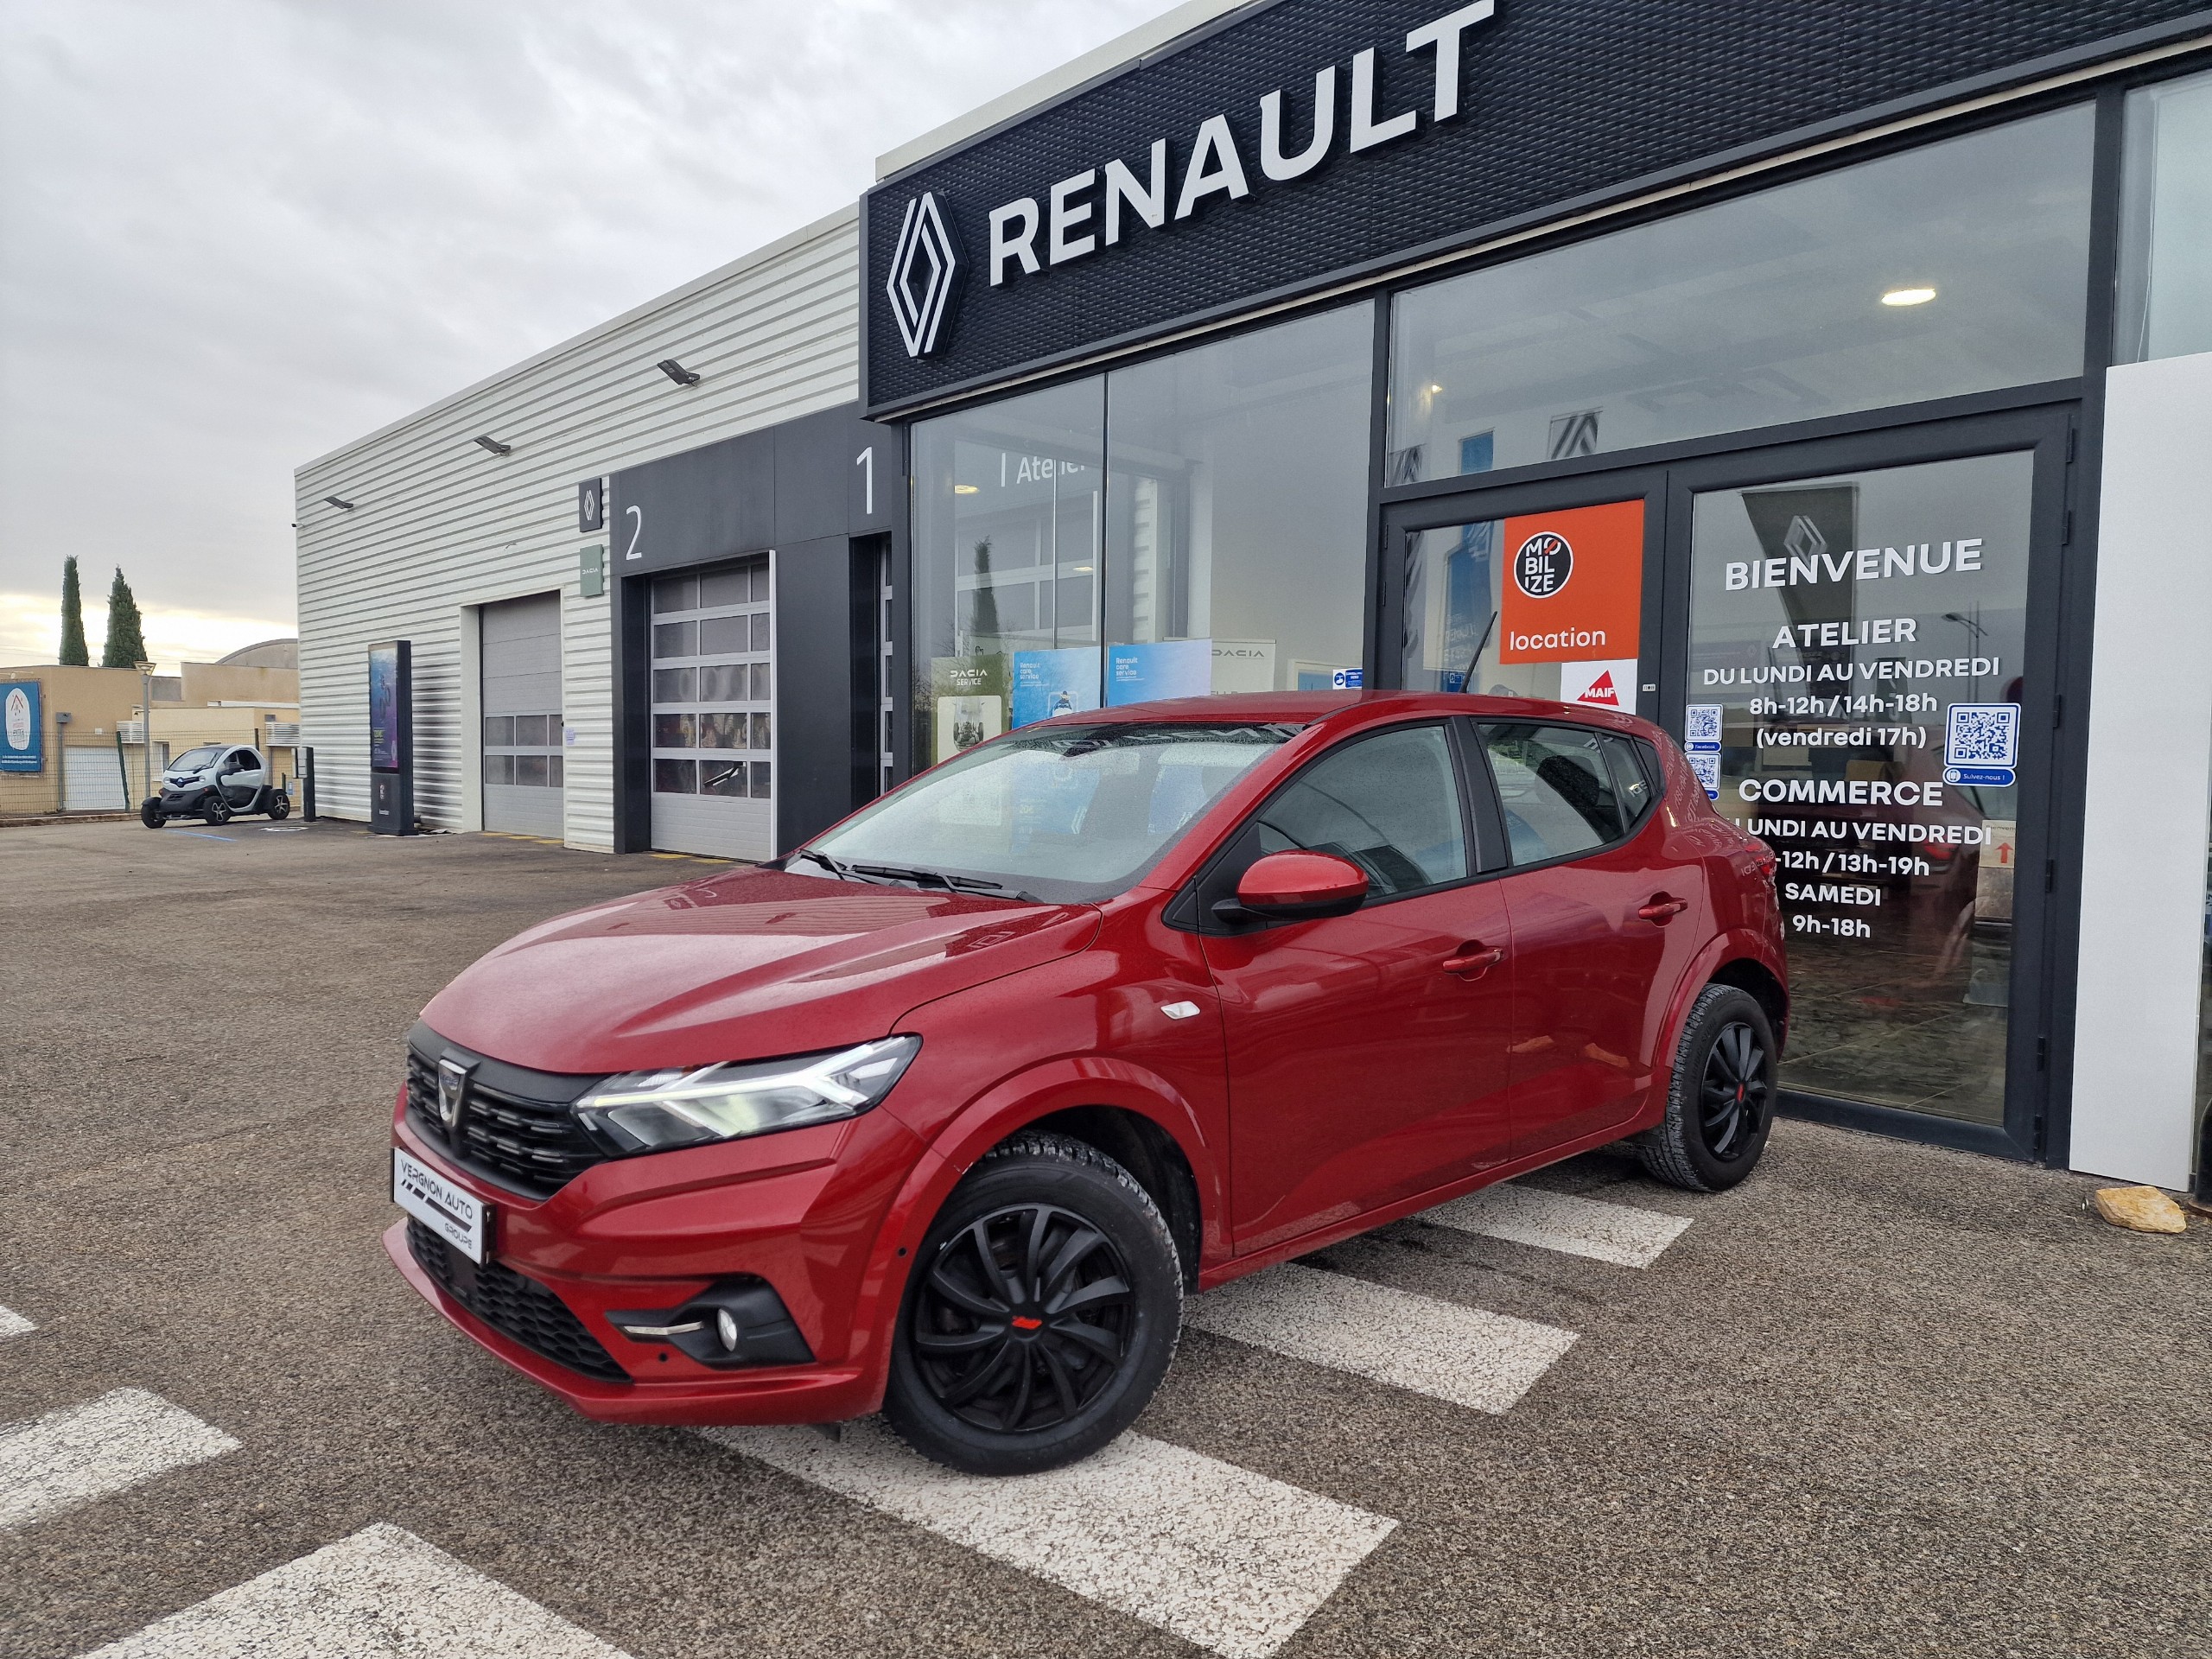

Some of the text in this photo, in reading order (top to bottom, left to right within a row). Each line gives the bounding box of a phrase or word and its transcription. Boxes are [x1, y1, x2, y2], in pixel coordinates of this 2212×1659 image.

[989, 0, 1494, 287] RENAULT
[856, 446, 873, 515] 1
[626, 505, 642, 561] 2
[1525, 555, 1554, 575] BIL
[1725, 537, 1983, 591] BIENVENUE
[1525, 574, 1554, 594] IZE
[1510, 626, 1606, 651] location
[1771, 618, 1916, 649] ATELIER
[950, 669, 988, 677] DACIA
[957, 677, 982, 686] SERVICE
[1703, 658, 1999, 685] DU LUNDI AU VENDREDI
[1584, 688, 1616, 698] MAIF
[1757, 726, 1927, 749] (vendredi 17h)
[1738, 779, 1944, 806] COMMERCE
[1810, 821, 1847, 839] AU
[1852, 822, 1992, 846] VENDREDI
[1784, 882, 1881, 906] SAMEDI
[1792, 914, 1872, 938] 9h-18h
[401, 1159, 474, 1220] VERGNON AUTO
[444, 1223, 473, 1250] GROUPE
